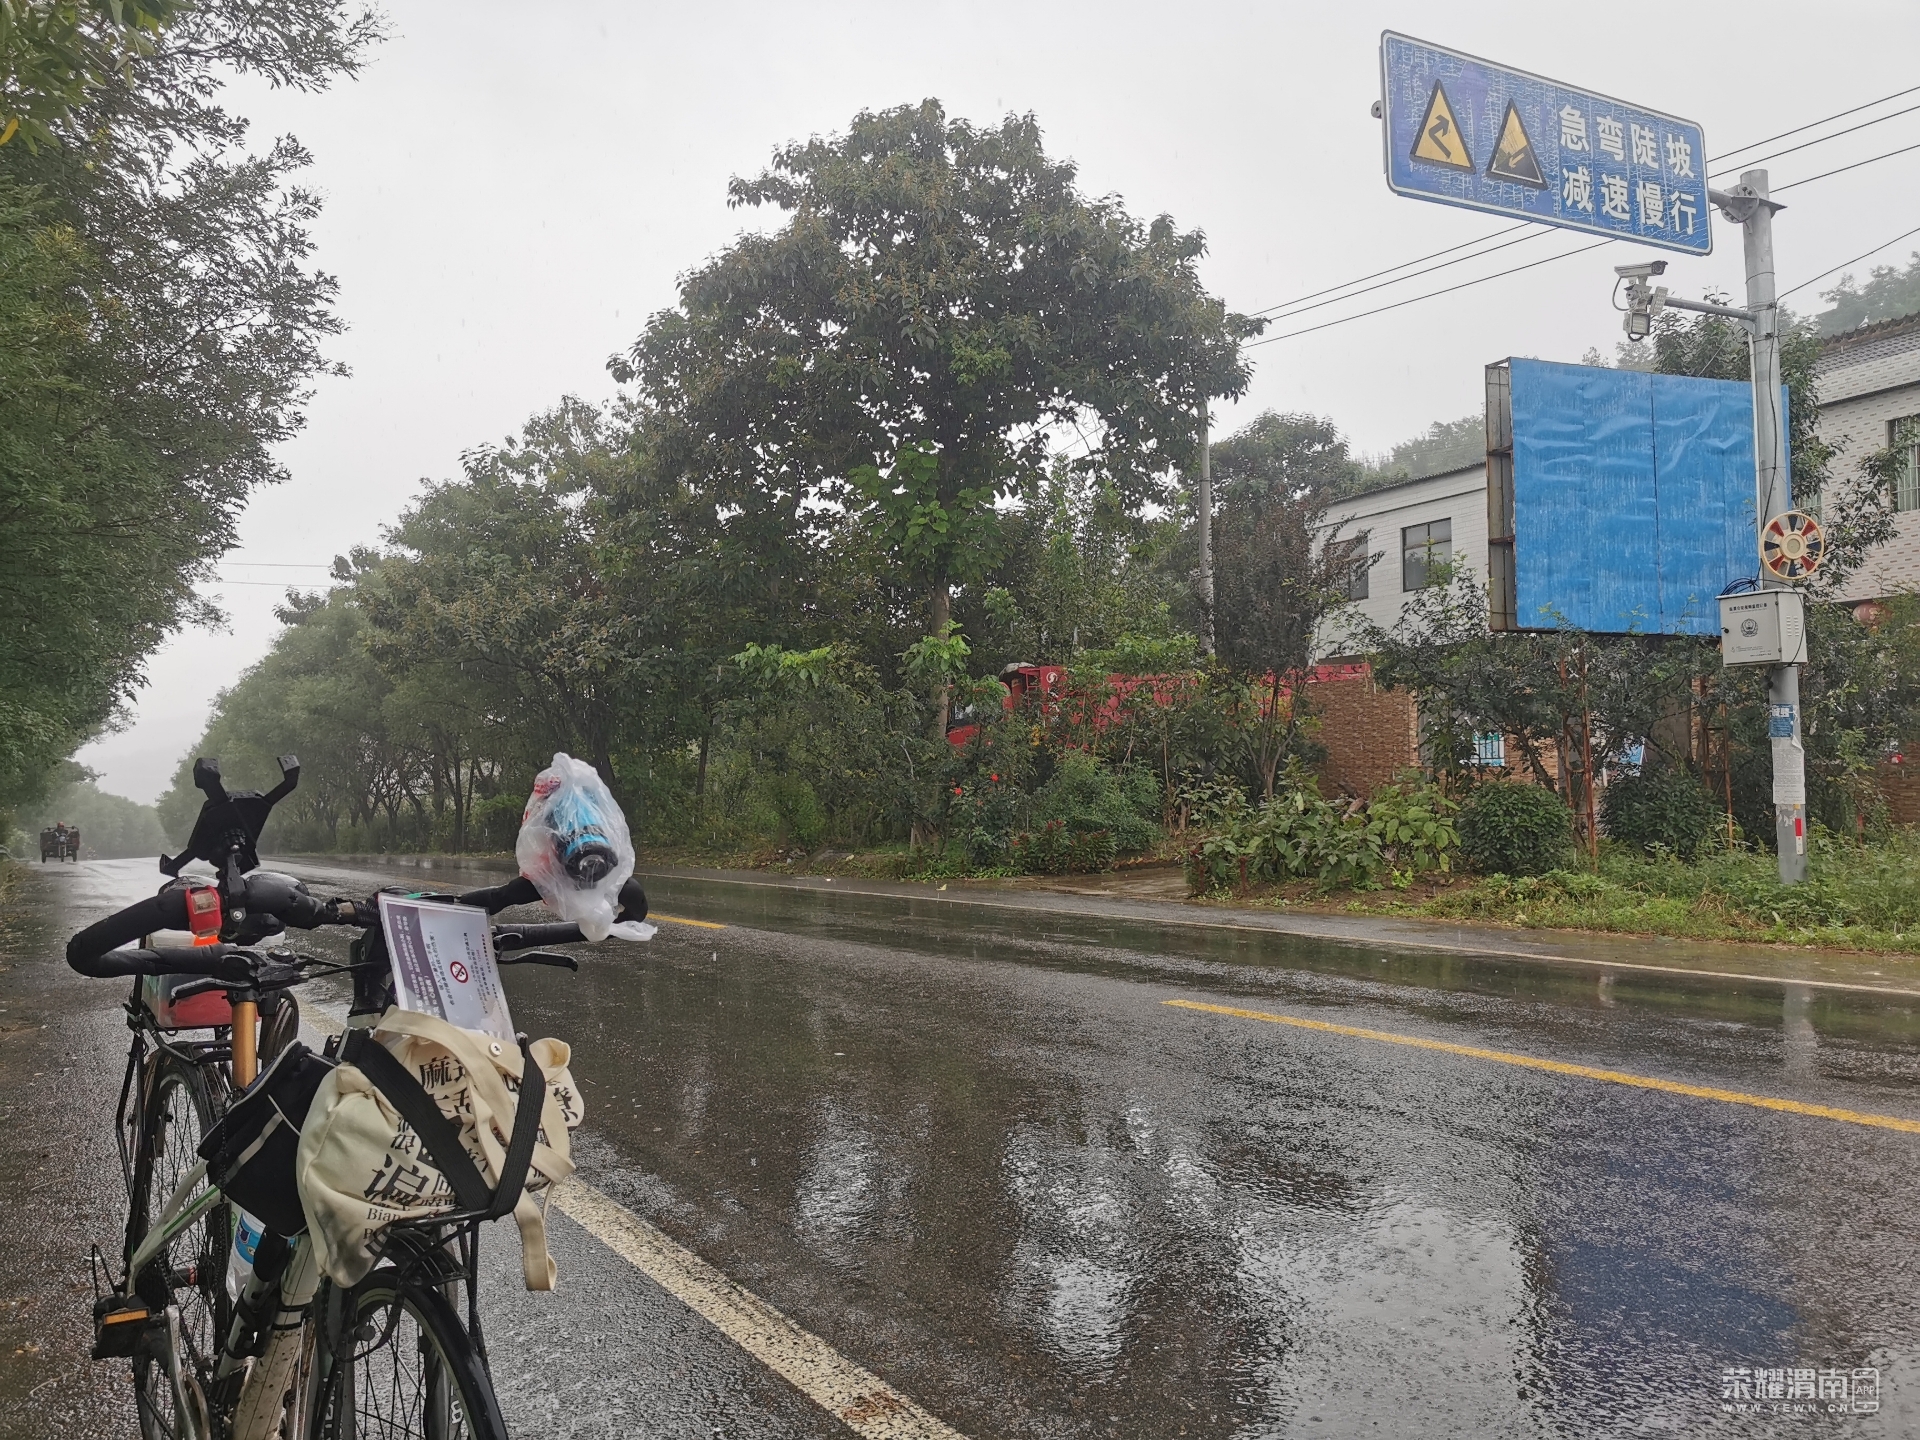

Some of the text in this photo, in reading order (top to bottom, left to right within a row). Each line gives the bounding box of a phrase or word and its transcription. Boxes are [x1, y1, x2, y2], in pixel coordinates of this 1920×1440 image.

[1558, 105, 1695, 179] 急弯陡坡
[1561, 166, 1698, 236] 减速慢行
